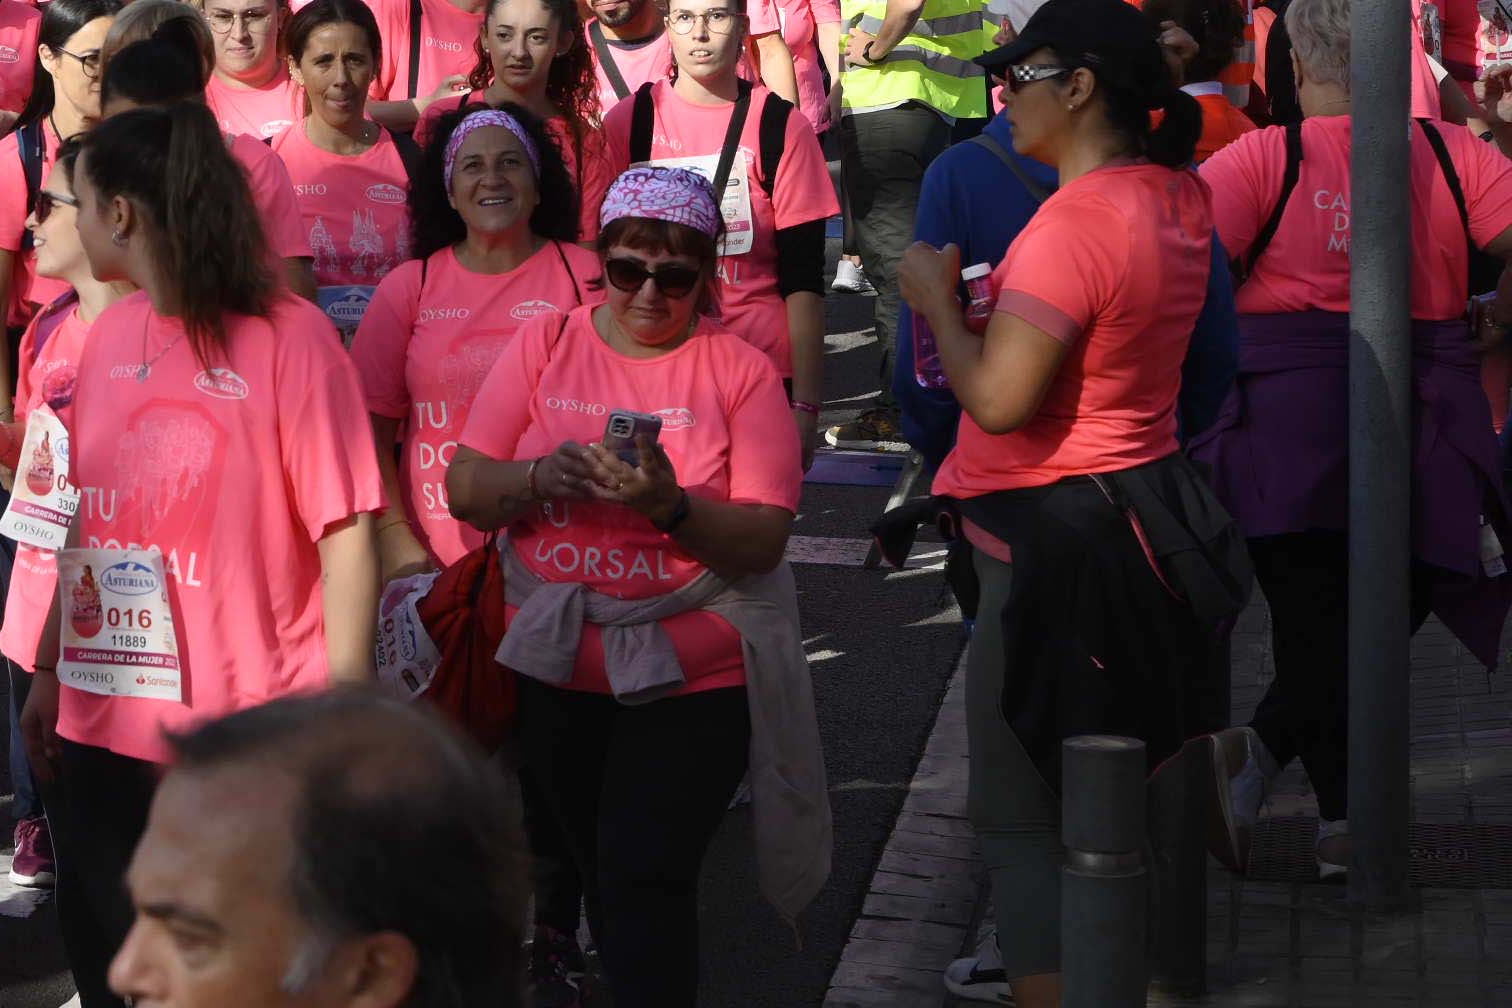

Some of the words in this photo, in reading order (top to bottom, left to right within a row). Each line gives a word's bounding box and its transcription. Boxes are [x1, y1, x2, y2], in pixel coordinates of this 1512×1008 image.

[425, 36, 463, 53] OYSHO
[419, 307, 470, 321] OYSHO
[546, 396, 607, 416] OYSHO
[416, 402, 447, 429] TU
[84, 486, 118, 522] TU
[13, 521, 54, 541] OYSHO
[104, 572, 157, 589] ASTURIANA
[107, 607, 152, 629] 016
[111, 634, 147, 649] 11889
[76, 651, 114, 662] CARRERA
[114, 652, 127, 663] DE
[128, 653, 137, 663] LA
[138, 653, 164, 665] MUJER
[71, 669, 114, 685] OYSHO
